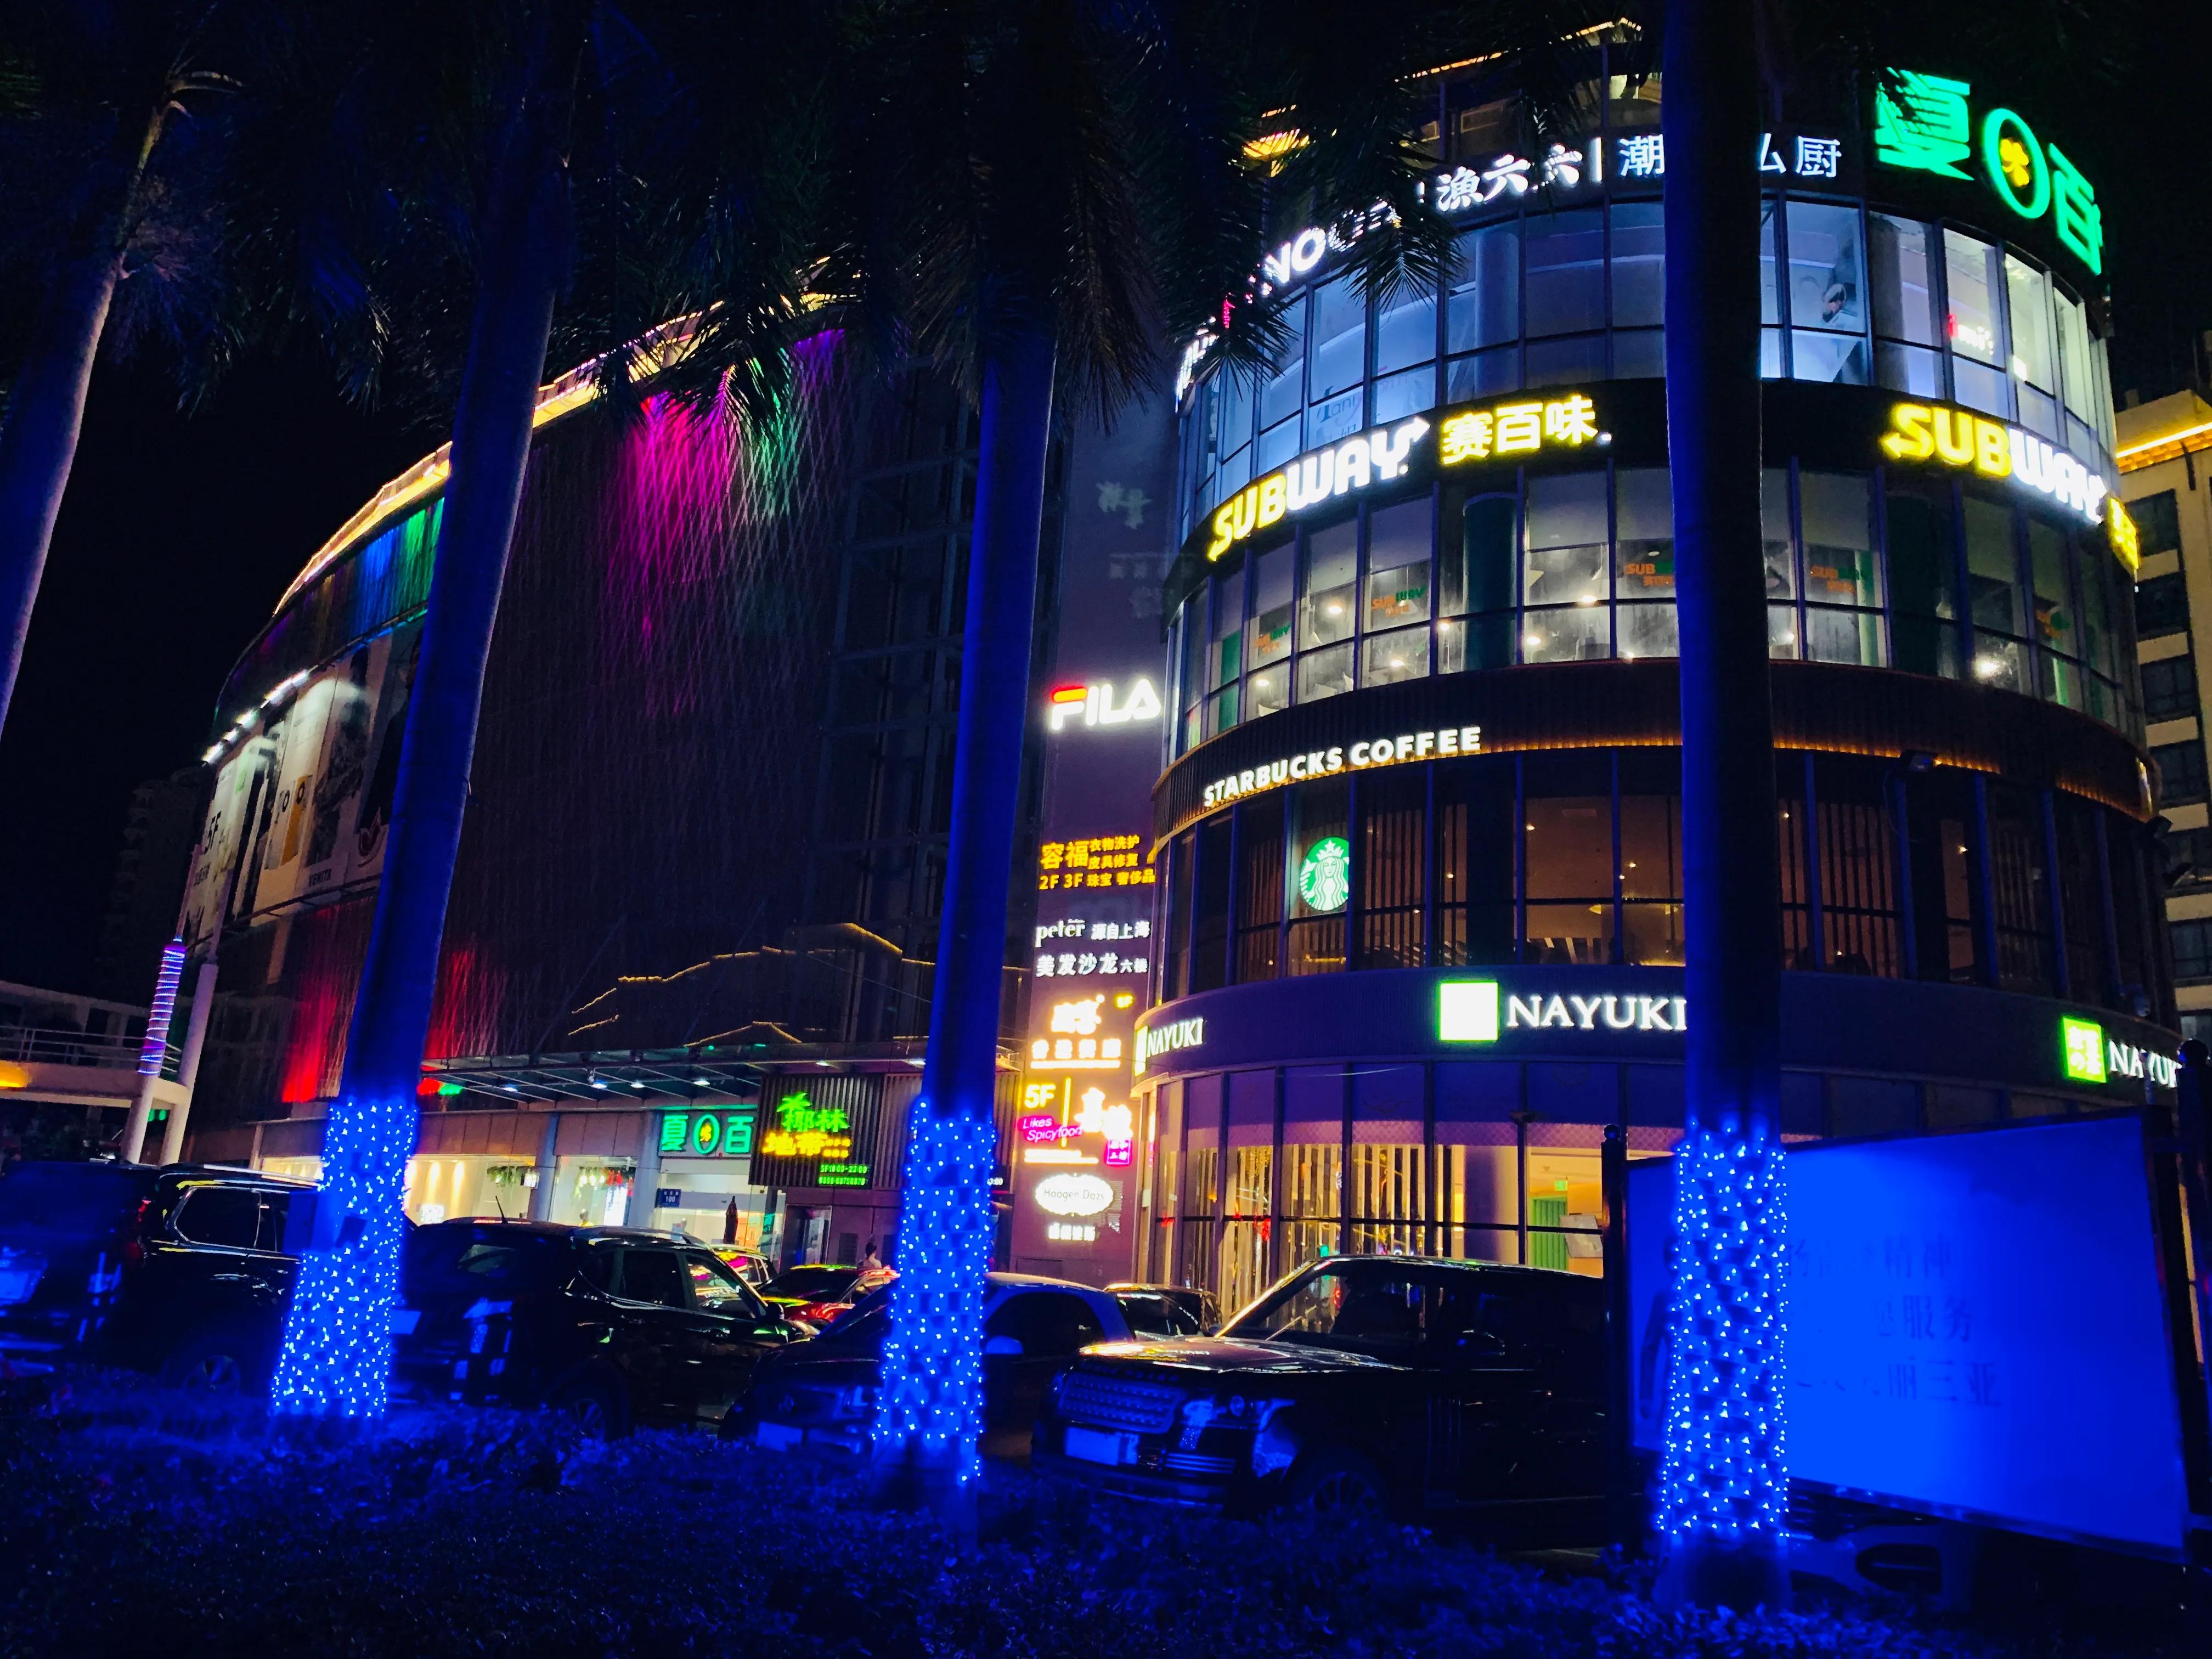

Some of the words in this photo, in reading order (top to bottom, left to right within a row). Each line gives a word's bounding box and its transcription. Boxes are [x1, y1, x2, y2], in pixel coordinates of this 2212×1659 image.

[1441, 394, 1598, 465] 赛百味
[1881, 403, 2107, 524] SUBWAY
[1208, 417, 1430, 561] SUBWAY
[1051, 679, 1161, 730] FILA
[1204, 747, 1343, 807] STARBUCKS
[1349, 726, 1481, 766] COFFEE
[1040, 840, 1089, 870] 容福
[1090, 834, 1140, 852] 衣物洗护
[1087, 853, 1138, 870] 皮具修复
[1039, 874, 1059, 890] 2F
[1063, 873, 1084, 888] 3F
[1087, 873, 1112, 887] 珠宝
[1116, 868, 1156, 885] 奢侈品
[1035, 920, 1086, 947] peter
[1091, 921, 1150, 940] 源自上海
[1036, 952, 1119, 978] 美发沙龙
[1507, 995, 1687, 1031] NAYUKI
[1147, 1017, 1204, 1058] NAYUKI
[2107, 1039, 2183, 1088] NAYUK
[776, 1092, 850, 1132] 椰林
[1024, 1084, 1056, 1109] 5F
[1023, 1118, 1052, 1130] Likes
